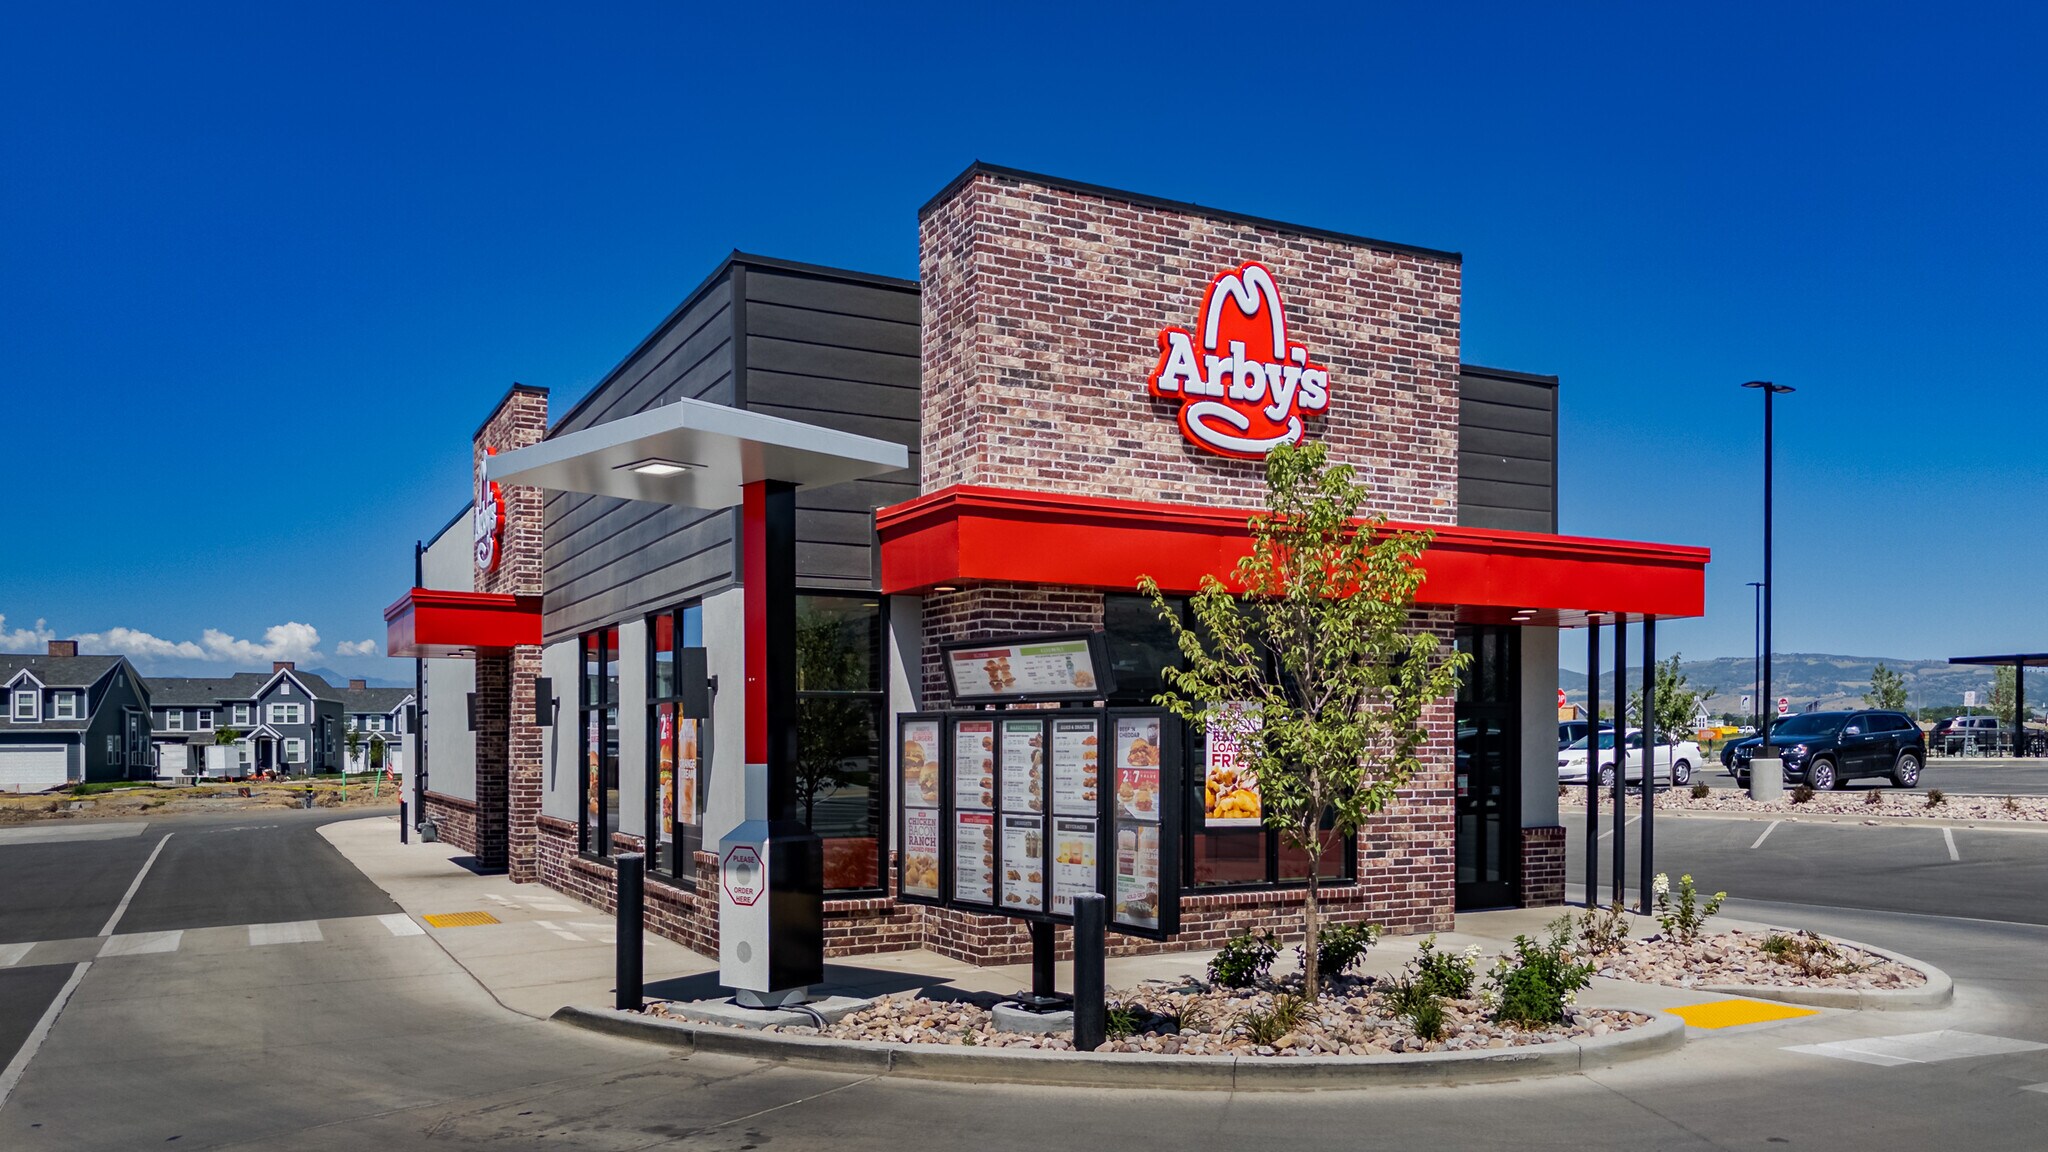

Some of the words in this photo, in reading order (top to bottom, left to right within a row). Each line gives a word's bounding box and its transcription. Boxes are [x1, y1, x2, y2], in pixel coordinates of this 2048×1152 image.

[1158, 331, 1327, 421] Arby's
[1122, 769, 1129, 783] 2
[908, 817, 937, 826] CHICKEN
[908, 825, 937, 836] BACON
[908, 835, 937, 847] RANCH
[732, 855, 755, 864] PLEASE
[733, 886, 754, 895] ORDER
[735, 895, 752, 903] HERE
